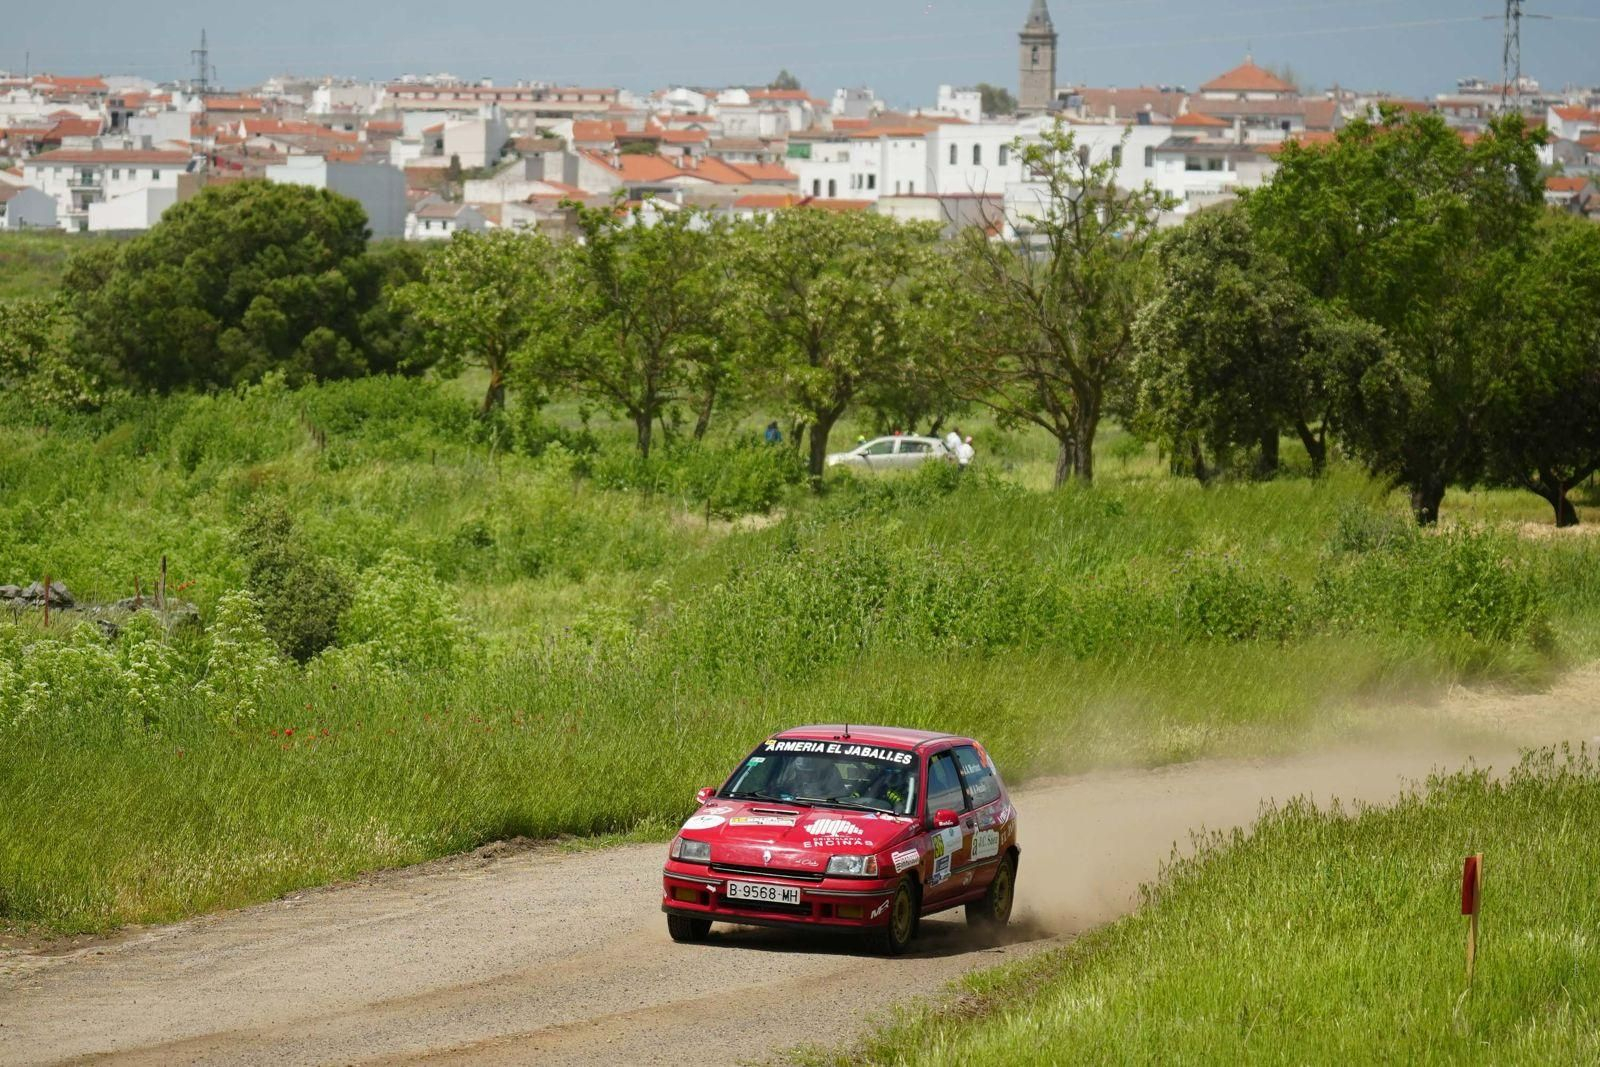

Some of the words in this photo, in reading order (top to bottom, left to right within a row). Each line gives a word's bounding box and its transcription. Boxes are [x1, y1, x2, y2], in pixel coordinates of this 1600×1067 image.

[765, 741, 825, 753] ARMERIA
[826, 744, 842, 754] EL
[844, 745, 913, 765] JABALI.ES
[803, 840, 874, 848] ENCINAS
